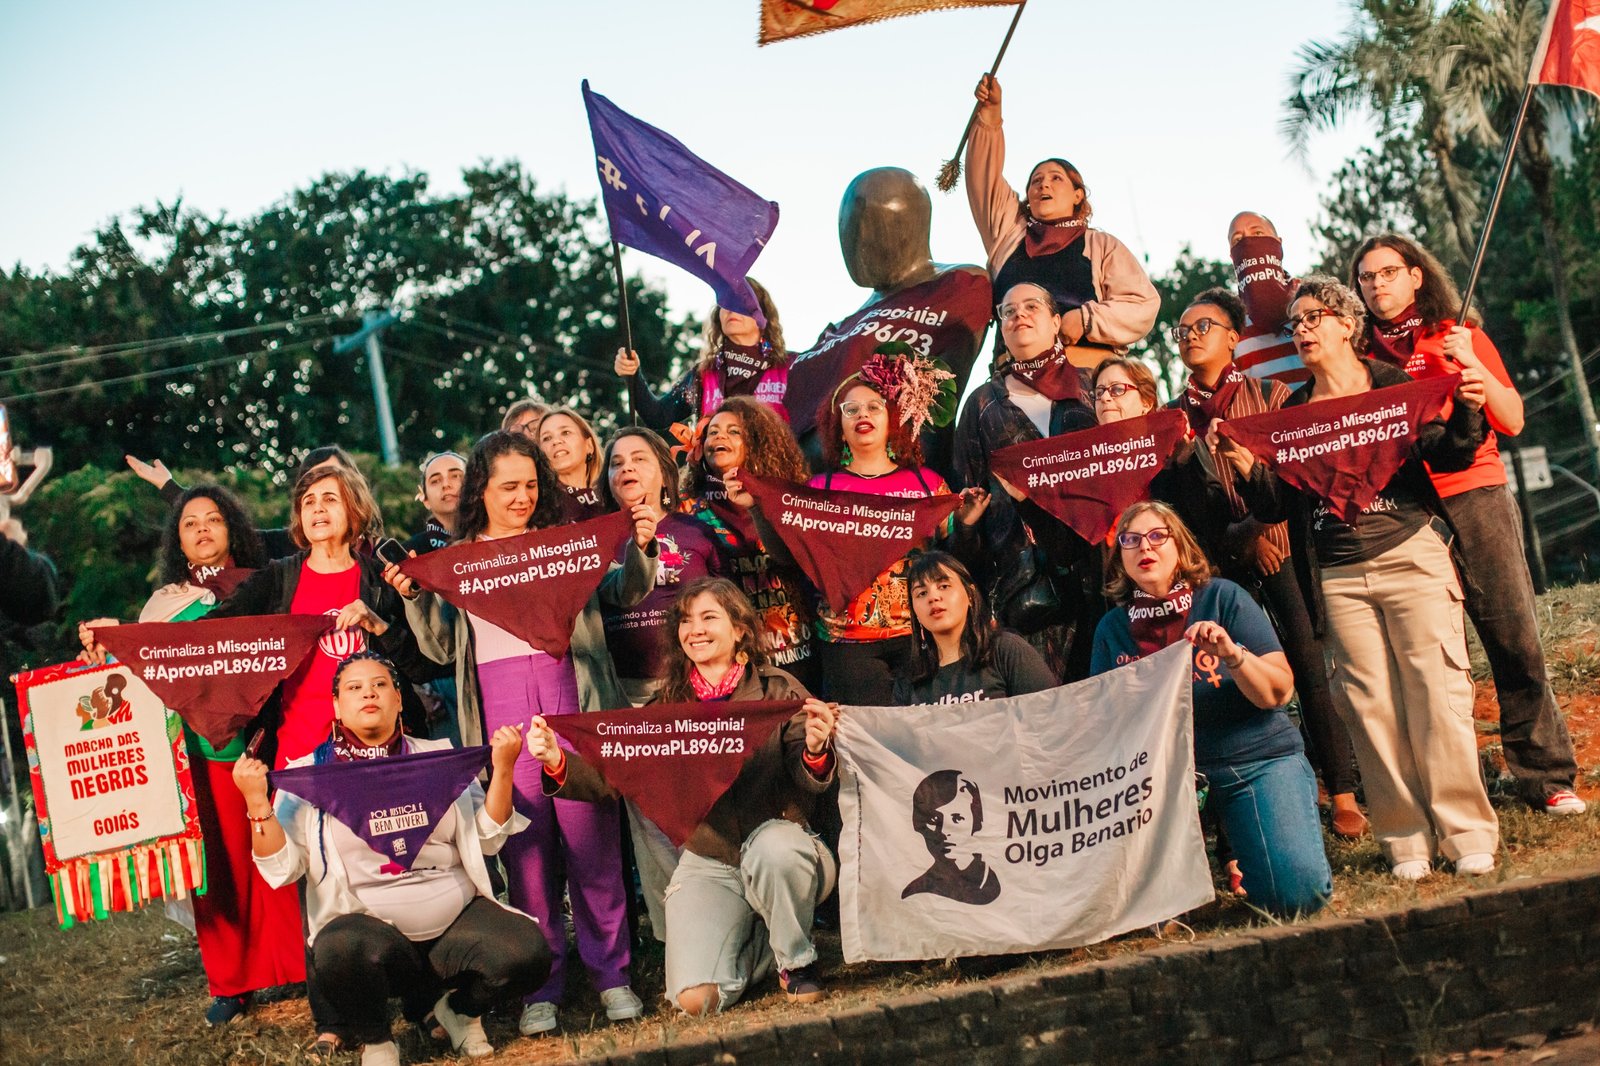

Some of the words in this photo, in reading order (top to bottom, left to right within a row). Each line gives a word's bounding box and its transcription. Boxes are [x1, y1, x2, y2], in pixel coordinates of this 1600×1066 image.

[1259, 256, 1266, 264] a
[1271, 422, 1331, 444] Criminaliza
[1334, 420, 1340, 430] a
[1342, 402, 1407, 428] Misoginia!
[1022, 450, 1081, 469] Criminaliza
[1083, 449, 1090, 458] a
[1092, 434, 1155, 456] Misoginia!
[1276, 421, 1409, 464] #AprovaPL896/23
[1028, 453, 1158, 488] #AprovaPL896/23
[782, 494, 841, 514] Criminaliza
[843, 505, 850, 514] a
[852, 505, 915, 522] Misoginia!
[781, 511, 913, 540] #AprovaPL896/23
[453, 554, 518, 575] Criminaliza
[520, 552, 528, 562] a
[529, 535, 598, 559] Misoginia!
[459, 554, 601, 595] #AprovaPL896/23
[139, 643, 205, 660] Criminaliza
[207, 645, 215, 654] a
[217, 638, 285, 655] Misoginia!
[143, 656, 287, 683] #AprovaPL896/23
[596, 721, 662, 736] Criminaliza
[665, 723, 672, 733] a
[674, 718, 745, 735] Misoginia!
[64, 737, 113, 757] MARCHA
[117, 731, 140, 746] DAS
[601, 738, 744, 761] #AprovaPL896/23
[67, 747, 145, 776] MULHERES
[70, 764, 148, 800] NEGRAS
[1004, 766, 1126, 804] Movimento
[1129, 751, 1148, 772] de
[370, 809, 387, 819] POR
[1006, 776, 1153, 839] Mulheres
[93, 809, 139, 836] GOIÁS
[374, 819, 393, 833] BEM
[396, 813, 424, 829] VIVER!
[1004, 841, 1063, 867] Olga
[1071, 808, 1153, 854] Benario
